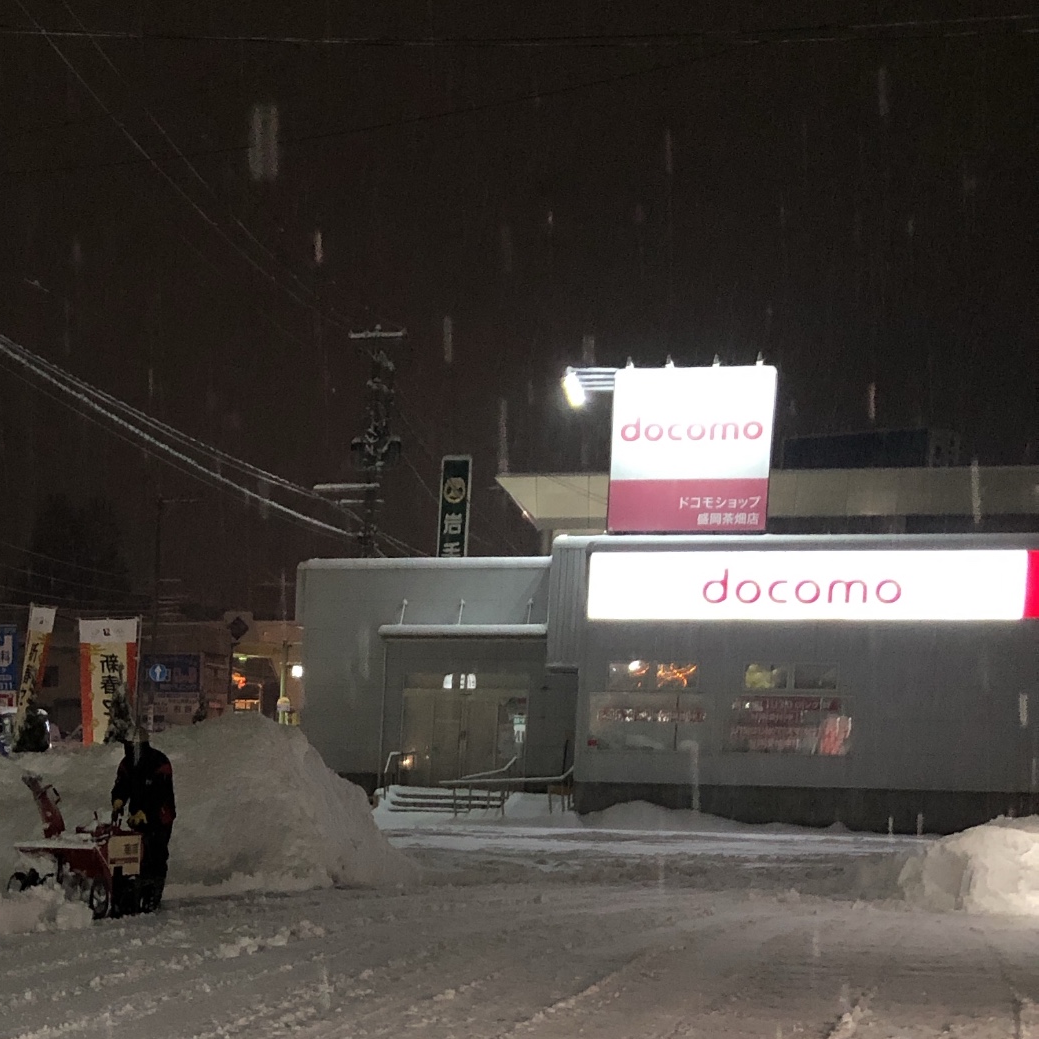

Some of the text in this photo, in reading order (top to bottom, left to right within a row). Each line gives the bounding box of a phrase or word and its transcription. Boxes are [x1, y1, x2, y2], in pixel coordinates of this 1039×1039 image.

[621, 416, 763, 442] docomo
[678, 496, 761, 510] ドコモショップ
[696, 512, 760, 526] 盛岡茶畑店
[702, 568, 902, 604] docomo
